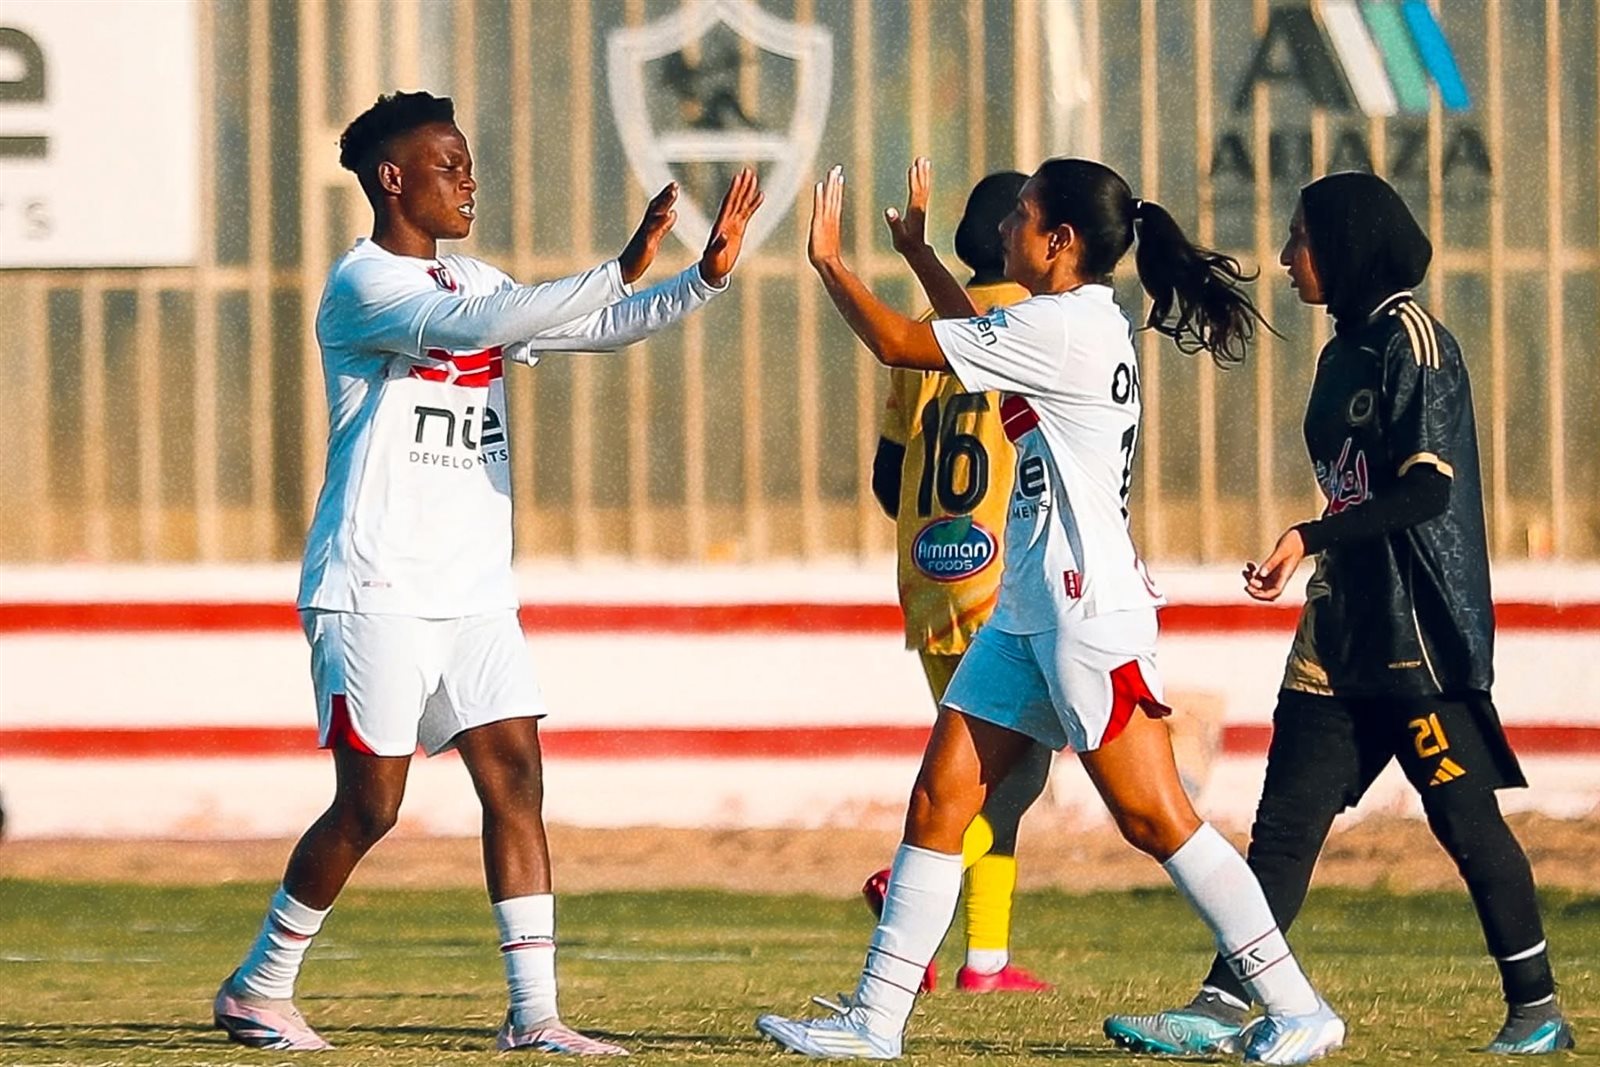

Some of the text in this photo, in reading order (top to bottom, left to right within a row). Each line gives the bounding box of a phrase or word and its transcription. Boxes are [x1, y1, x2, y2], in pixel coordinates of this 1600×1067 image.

[977, 317, 998, 346] en
[917, 391, 990, 519] 16
[918, 541, 988, 559] Amman
[929, 560, 974, 571] FOODS
[1408, 712, 1450, 759] 21
